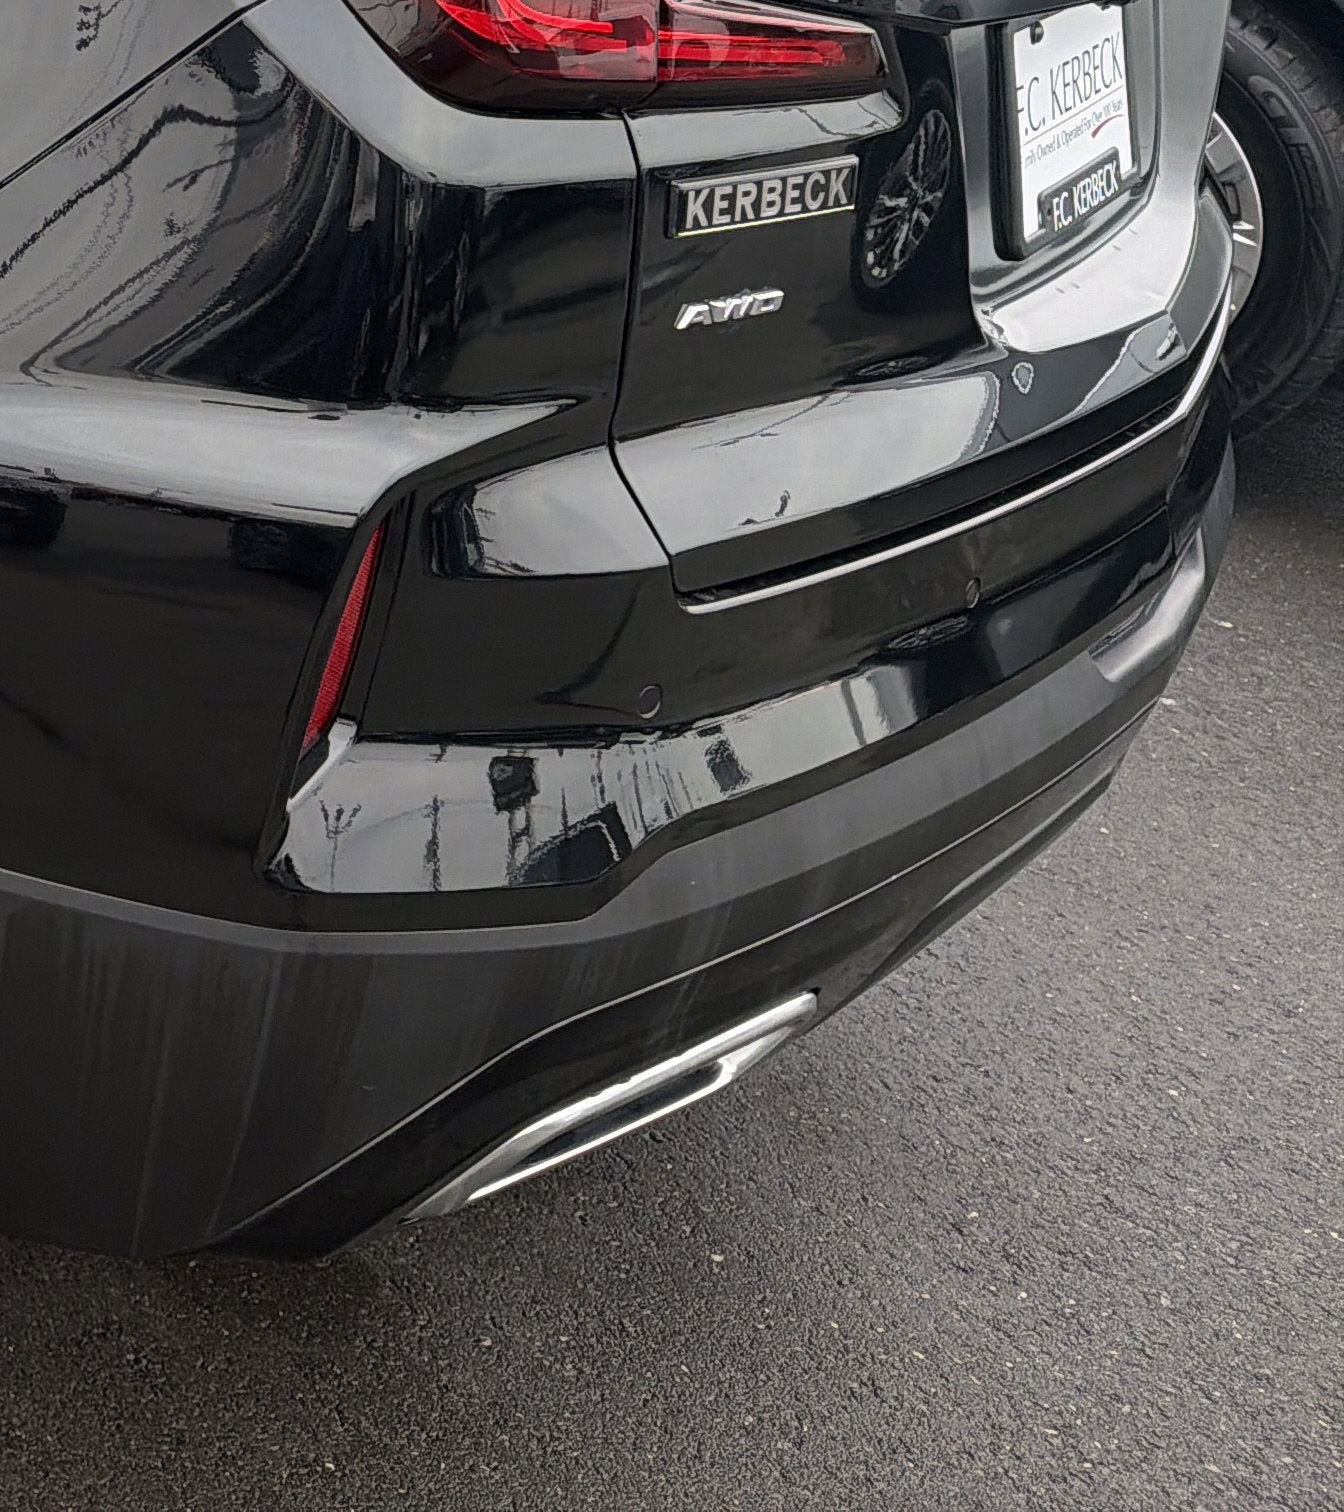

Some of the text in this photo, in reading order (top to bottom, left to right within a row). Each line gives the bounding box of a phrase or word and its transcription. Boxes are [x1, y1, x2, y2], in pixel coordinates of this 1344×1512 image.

[1049, 31, 1123, 121] KERBECK
[685, 167, 851, 230] KERBECK
[1072, 159, 1119, 219] KERBECK
[673, 289, 785, 330] AWD
